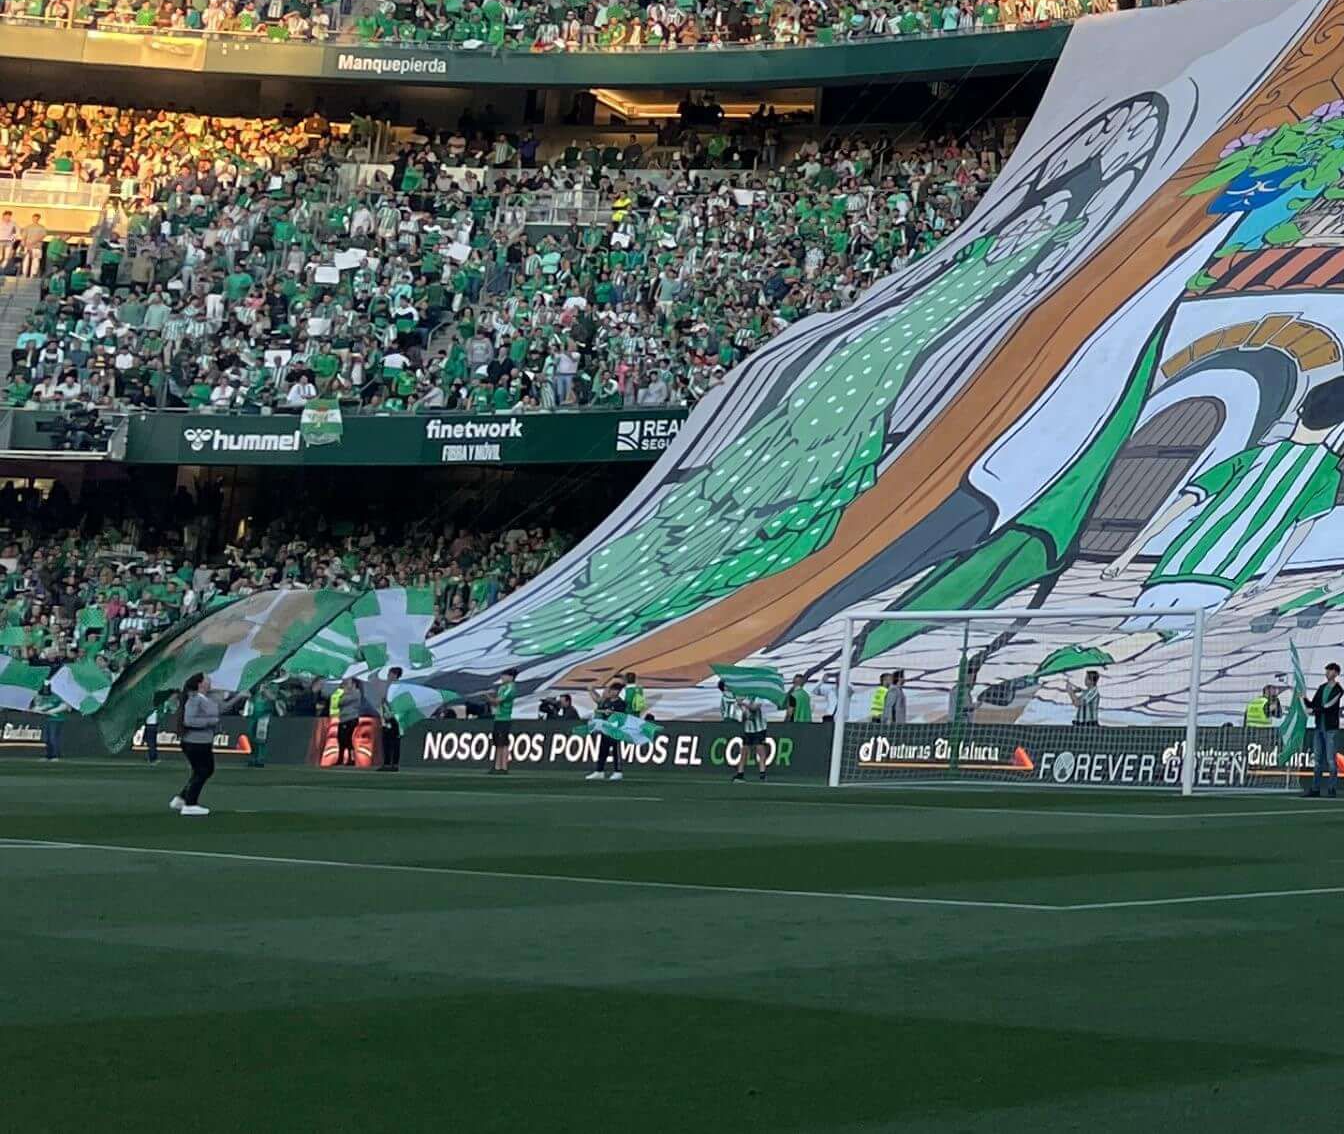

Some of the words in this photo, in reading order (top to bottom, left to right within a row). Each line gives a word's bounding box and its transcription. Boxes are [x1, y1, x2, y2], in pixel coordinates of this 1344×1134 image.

[337, 53, 447, 74] Manquepierda
[425, 417, 524, 439] finetwork
[212, 429, 301, 452] hummel
[549, 732, 669, 765] PONMOS
[673, 735, 702, 765] EL
[1162, 754, 1247, 785] GEEN
